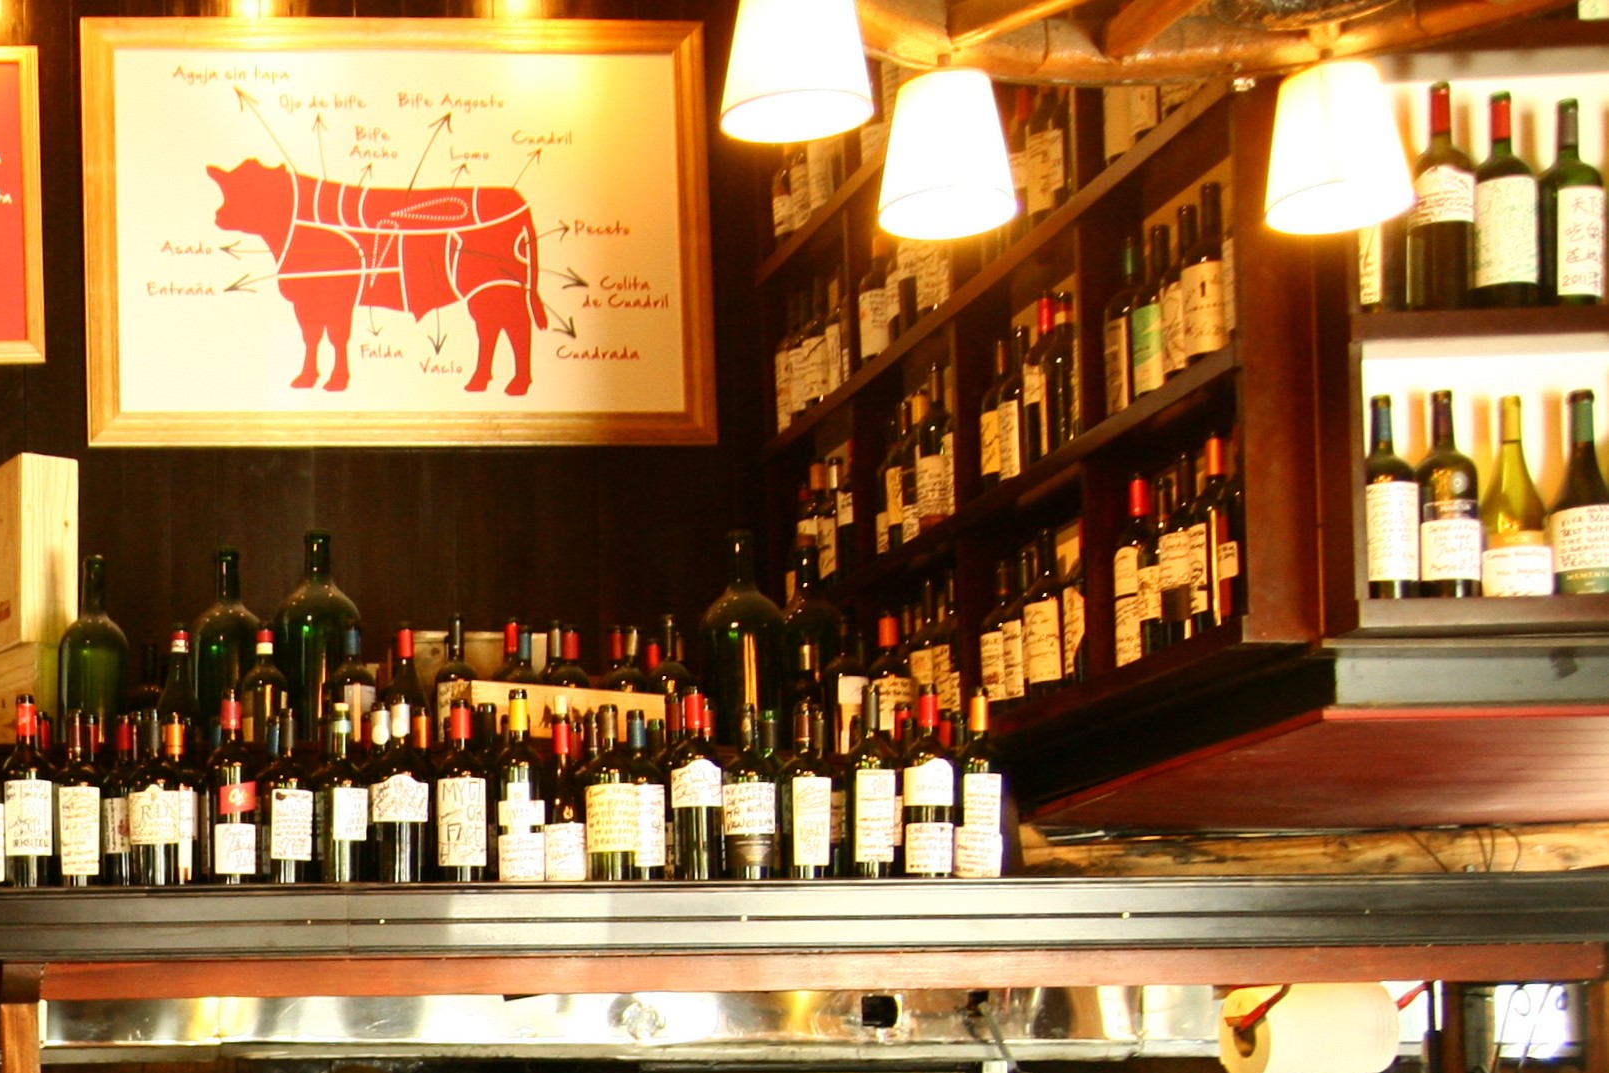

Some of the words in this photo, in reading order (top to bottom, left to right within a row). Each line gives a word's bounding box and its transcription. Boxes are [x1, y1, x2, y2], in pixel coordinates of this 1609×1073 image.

[173, 65, 218, 85] Aguja
[225, 67, 247, 80] sin
[253, 65, 289, 85] tapa
[279, 93, 302, 113] Ojo
[308, 95, 329, 109] de
[334, 93, 367, 111] bife
[397, 92, 433, 108] Bife
[440, 93, 504, 114] Angosto
[355, 126, 390, 142] Bife
[511, 129, 573, 145] Cuadril
[349, 145, 398, 160] Ancho
[449, 146, 490, 160] Lomo
[575, 219, 630, 236] Peceto
[161, 240, 212, 256] Asado
[147, 281, 214, 296] Entraña
[600, 275, 650, 291] Colita
[582, 294, 601, 308] de
[608, 293, 669, 308] Cuadril
[360, 344, 403, 358] Falda
[556, 345, 640, 360] Cuadrada
